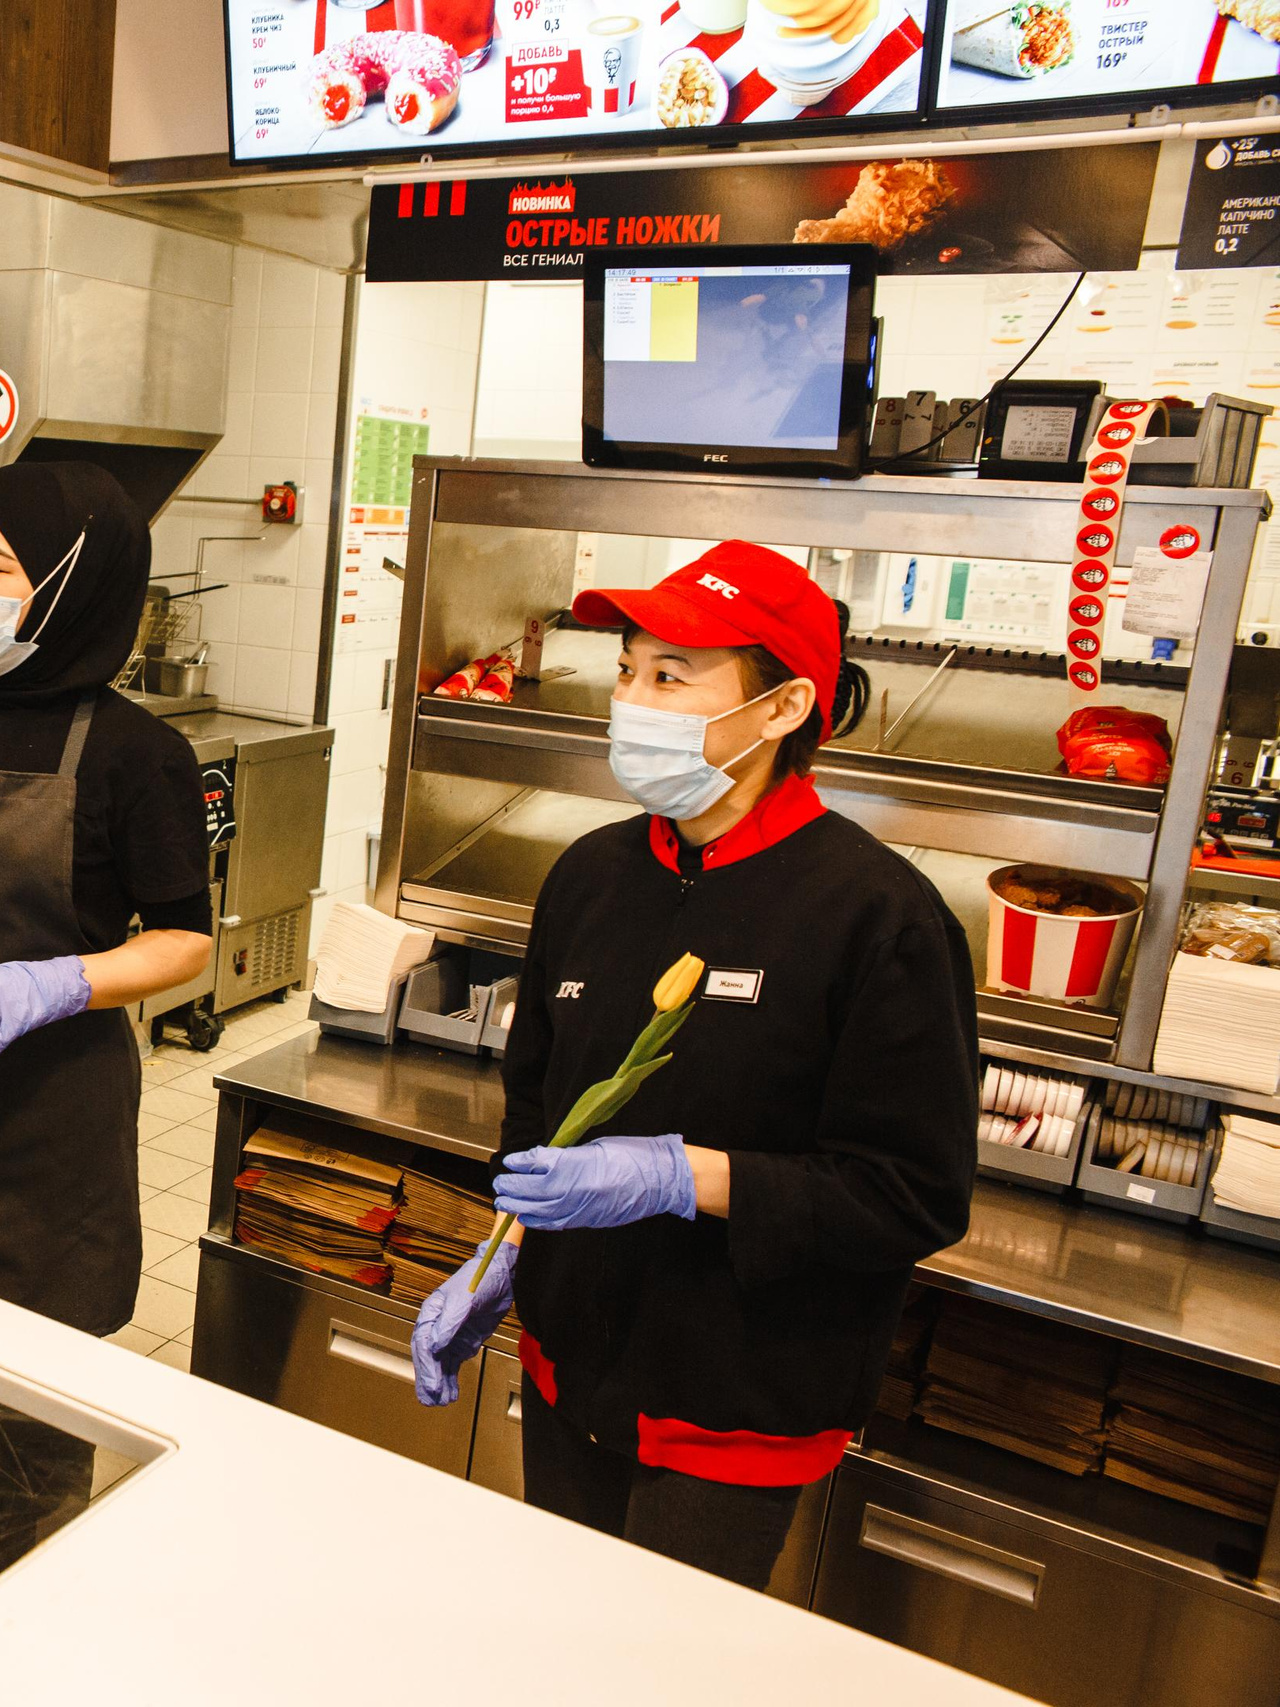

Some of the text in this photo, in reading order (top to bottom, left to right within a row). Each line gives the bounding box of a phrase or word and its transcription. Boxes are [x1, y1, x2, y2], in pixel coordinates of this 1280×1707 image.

[251, 14, 284, 24] КЛУБНИКА
[544, 19, 560, 33] 0,3
[1101, 20, 1148, 35] ТВИСТЕР
[1098, 31, 1144, 49] ОСТРЫЙ
[518, 46, 562, 62] ДОБАВЬ
[253, 61, 296, 74] КЛУБНИЧНЫЙ
[255, 107, 279, 116] ЯБЛОКО
[255, 118, 279, 126] КОРИЦА
[512, 196, 571, 212] НОВИНКА
[1220, 209, 1275, 222] КАПУЧИНО
[506, 214, 721, 248] ОСТРЫЕ НОЖКИ
[1217, 223, 1250, 235] ЛАТТЕ
[1214, 238, 1239, 255] 0,2
[503, 255, 528, 267] ВСЕ
[886, 400, 896, 412] 8
[916, 392, 927, 406] 7
[960, 401, 971, 415] 6
[703, 454, 728, 463] FEC
[696, 573, 740, 600] KFC
[555, 981, 585, 999] KFC
[719, 980, 744, 989] Жанна
